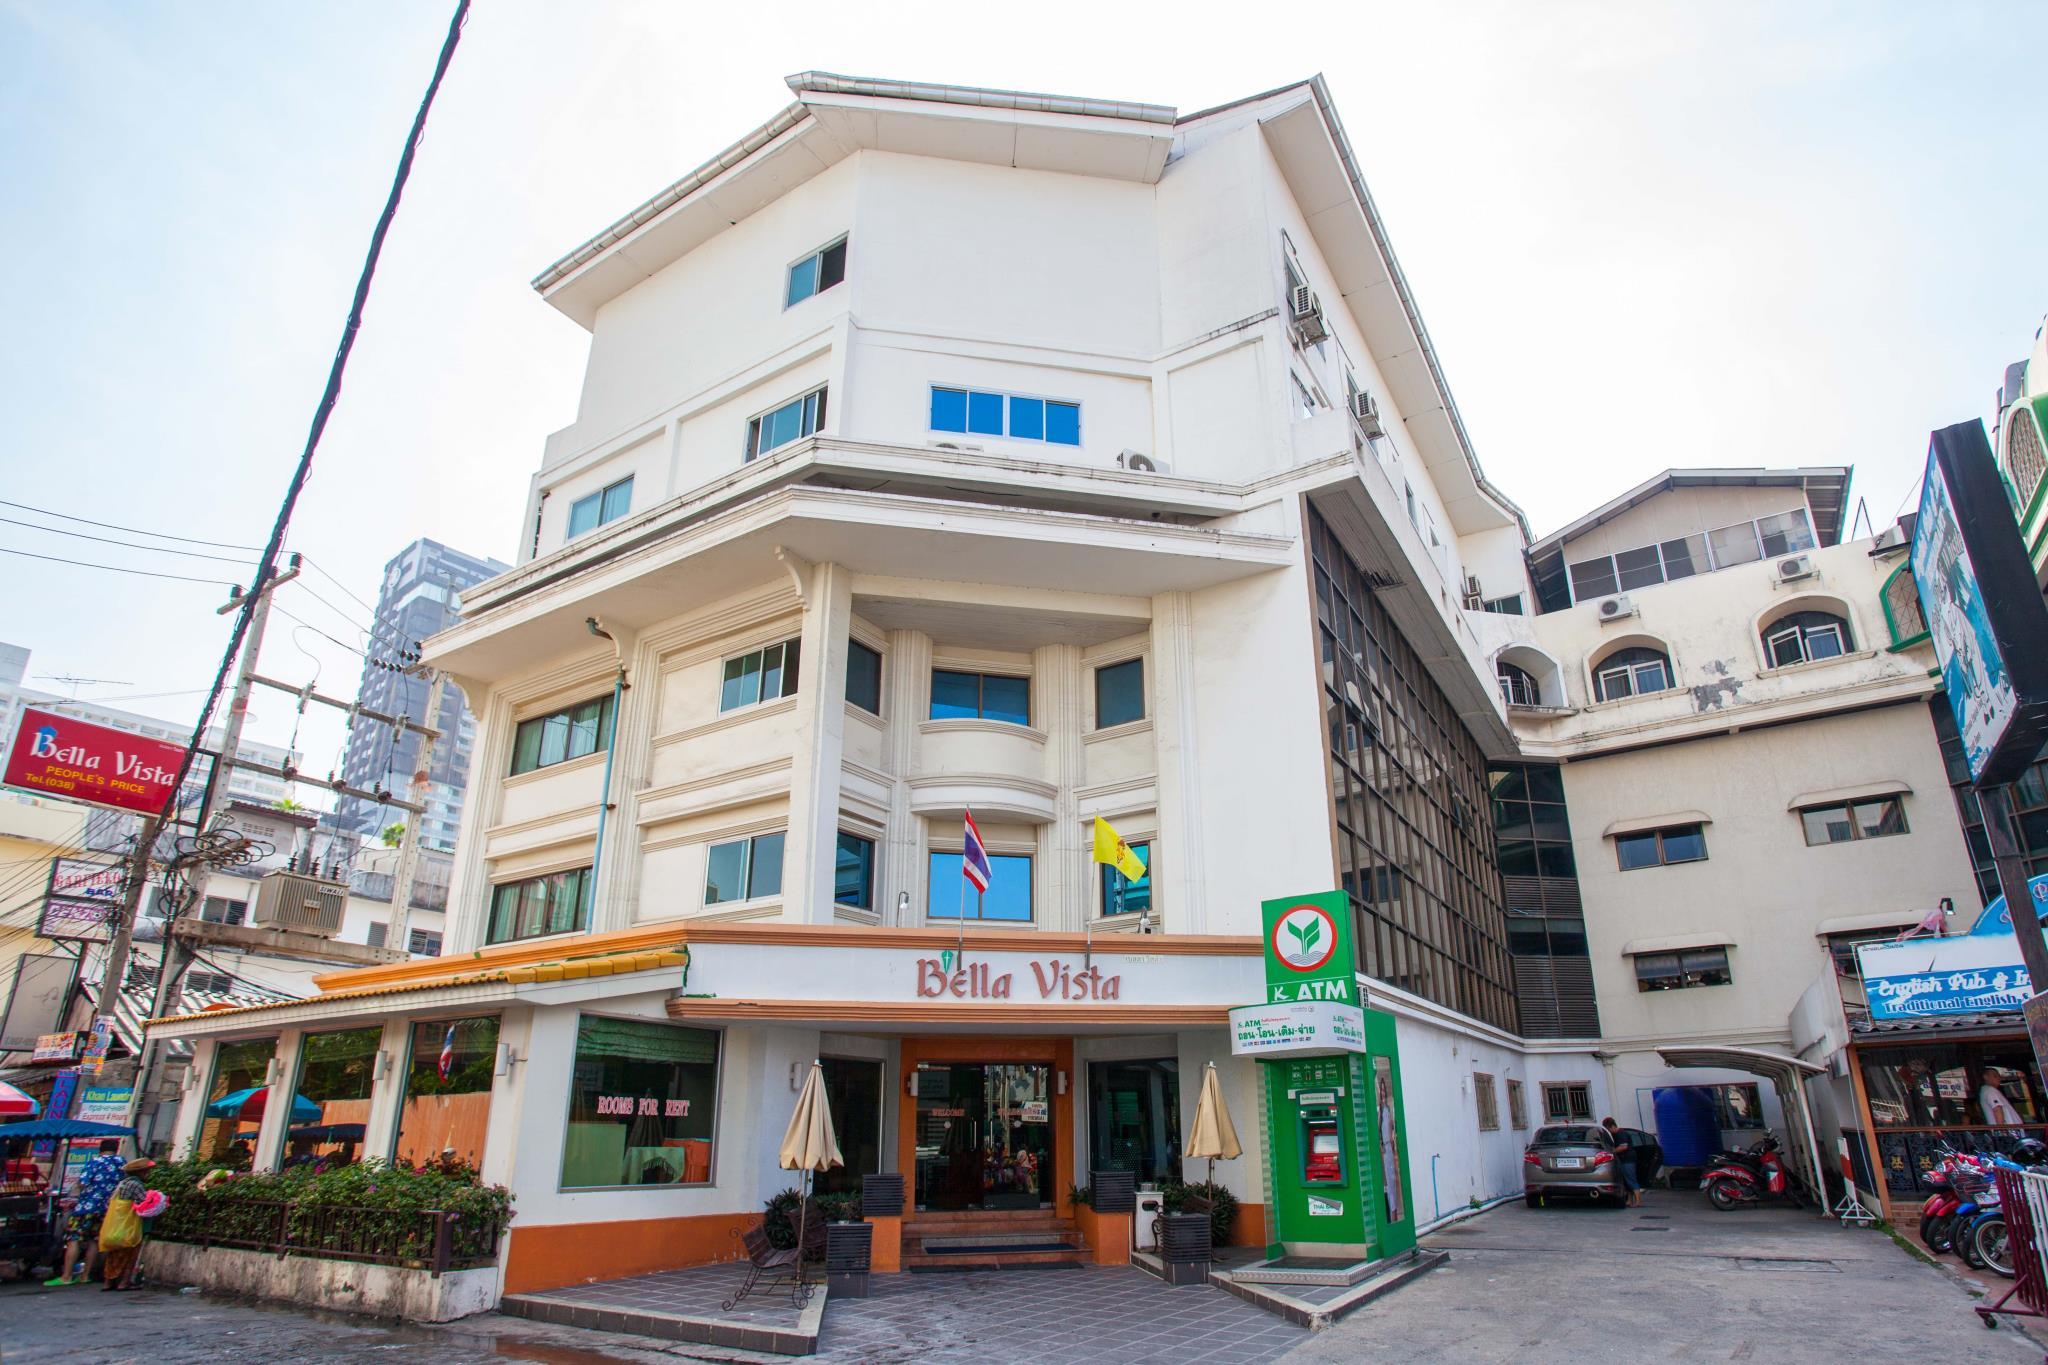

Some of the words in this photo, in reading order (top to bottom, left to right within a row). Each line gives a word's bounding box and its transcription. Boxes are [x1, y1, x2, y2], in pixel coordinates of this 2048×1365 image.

[30, 731, 101, 769] Bella
[115, 751, 175, 787] Vista
[46, 765, 105, 785] PEOPLE'S
[110, 779, 146, 794] PRICE
[85, 887, 114, 897] BAR
[917, 958, 1012, 998] Bella
[1029, 959, 1121, 1000] Vista
[1296, 979, 1348, 1000] ATM
[1879, 976, 1943, 998] English
[1948, 972, 1986, 991] Pub
[1992, 971, 2009, 991] &
[1884, 996, 1961, 1014] Traditional
[1964, 992, 2017, 1008] English
[1244, 1019, 1261, 1028] ATM
[597, 1095, 634, 1115] ROOMS
[637, 1098, 659, 1116] FOR
[664, 1099, 690, 1117] RENT
